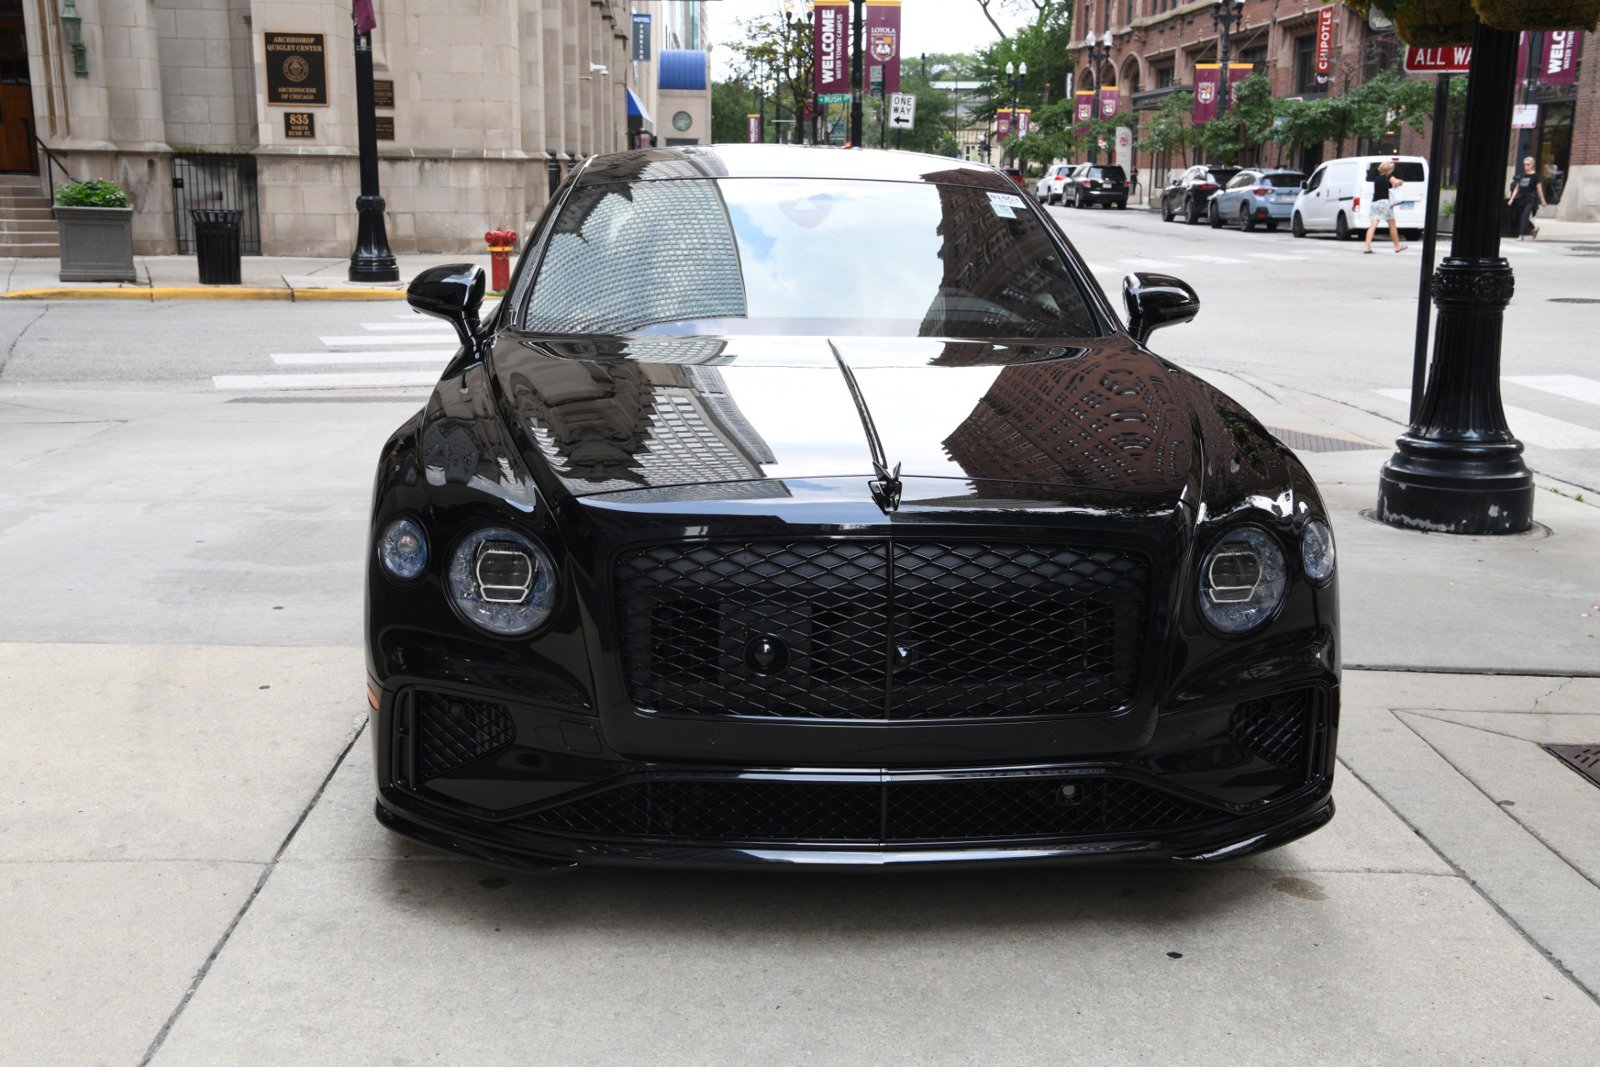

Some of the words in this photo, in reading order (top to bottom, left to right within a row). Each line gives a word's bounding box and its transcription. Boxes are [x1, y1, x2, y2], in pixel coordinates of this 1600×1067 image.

[272, 36, 316, 44] ARCHBISHOP
[1318, 11, 1332, 70] CHIPOTLE
[267, 44, 296, 52] QUIGLEY
[821, 9, 835, 84] WELCOME
[1414, 48, 1446, 65] ALL
[1563, 49, 1572, 70] WATER
[894, 96, 912, 105] ONE
[893, 106, 912, 115] WAY
[289, 114, 309, 125] 835
